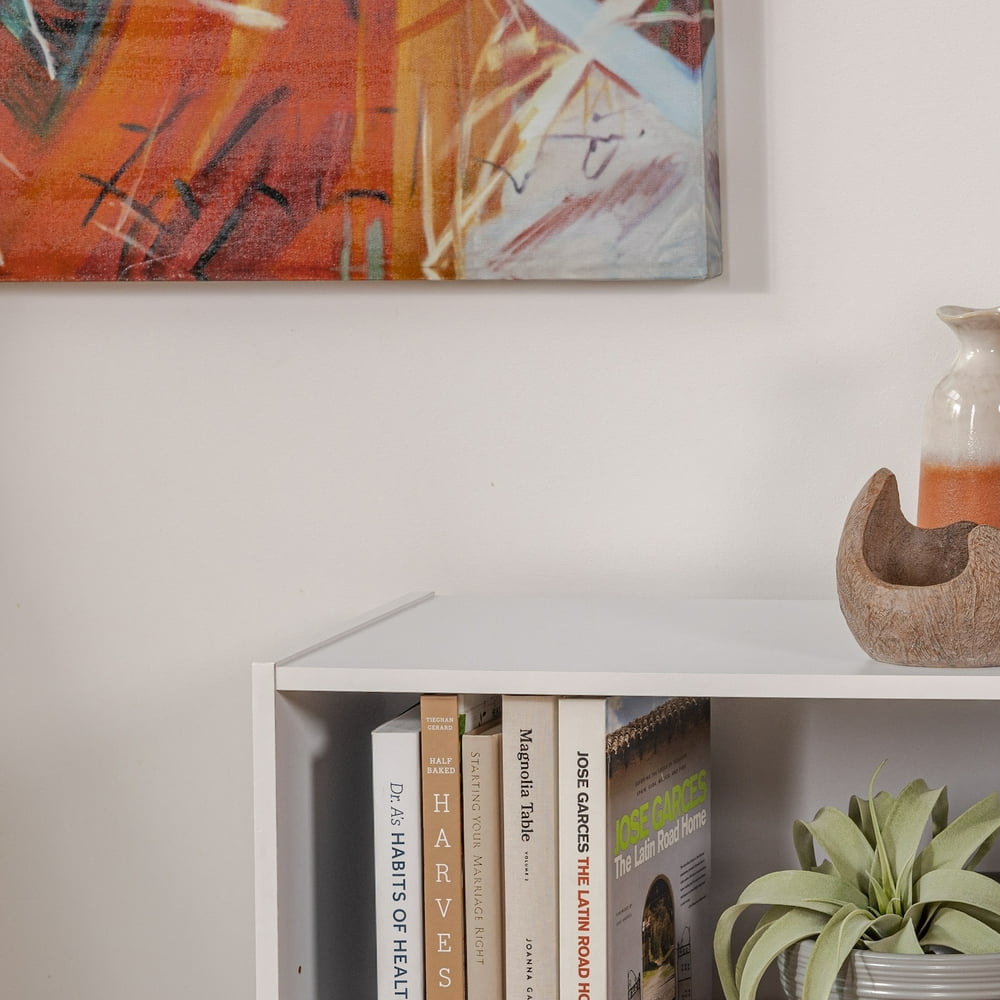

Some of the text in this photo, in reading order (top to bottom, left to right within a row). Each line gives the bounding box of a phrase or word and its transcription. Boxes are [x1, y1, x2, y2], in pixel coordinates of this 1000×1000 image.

[426, 766, 456, 774] BAKED
[430, 757, 453, 765] HALF
[389, 782, 404, 802] Dr.
[517, 728, 534, 842] Magnolia Table
[577, 751, 590, 853] JOSE GARCES
[613, 802, 650, 856] JOSE
[652, 769, 707, 832] GARCES
[470, 752, 485, 965] STARTING YOUR MARRIAGE RIGHT
[614, 808, 707, 880] The Latin Road Home
[390, 832, 406, 902] HABITS
[578, 857, 590, 886] THE
[392, 908, 407, 934] OF
[578, 890, 590, 932] LATIN
[578, 936, 590, 979] ROAD
